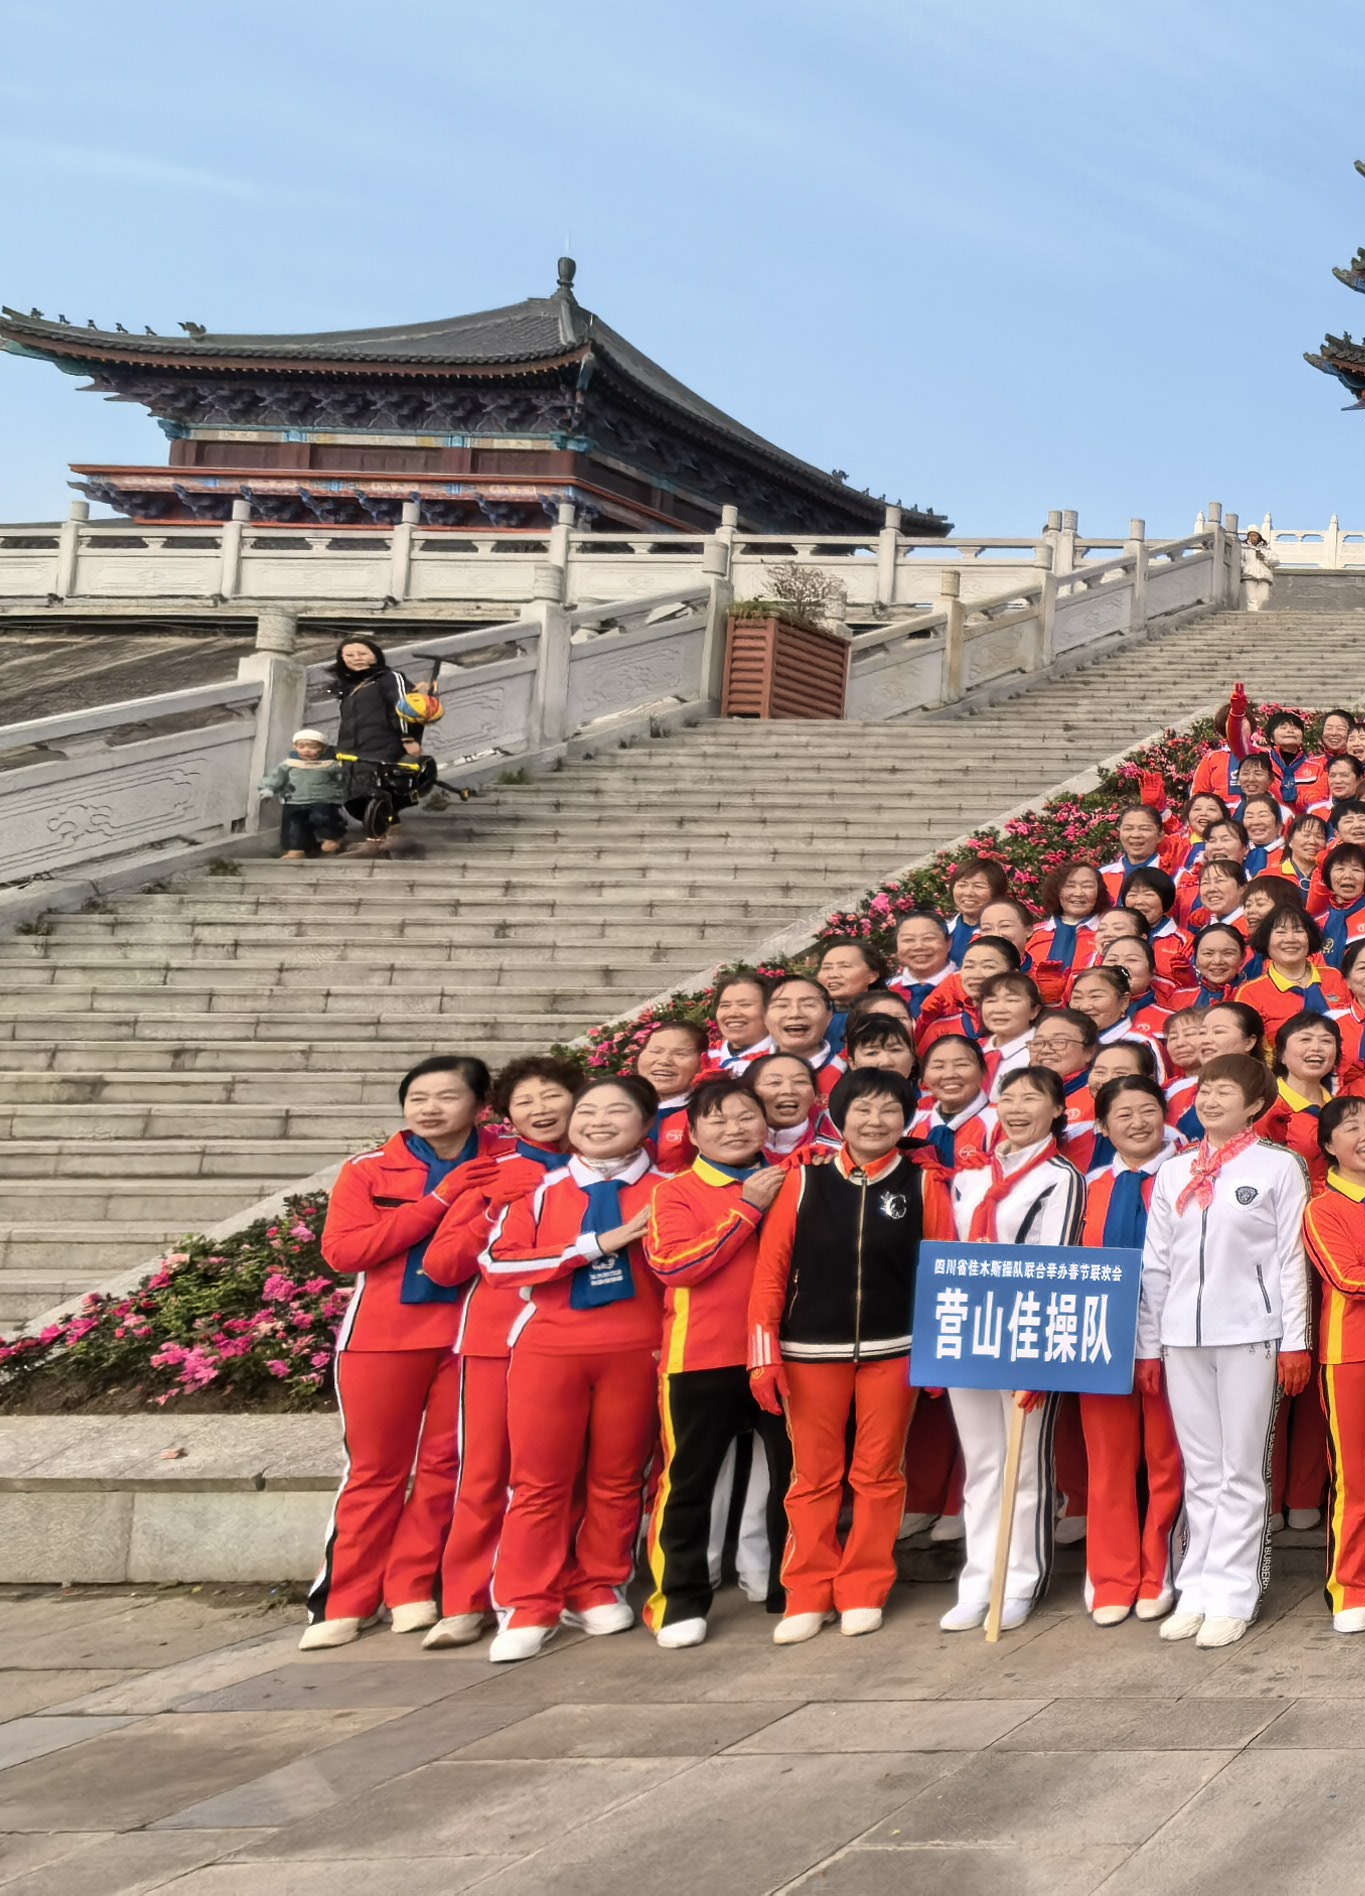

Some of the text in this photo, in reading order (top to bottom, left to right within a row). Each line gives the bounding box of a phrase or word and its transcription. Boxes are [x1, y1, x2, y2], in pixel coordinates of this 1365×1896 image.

[934, 1257, 1123, 1282] 四川省佳木斯操队联合举办春节联欢会
[934, 1286, 1113, 1366] 营山佳操队
